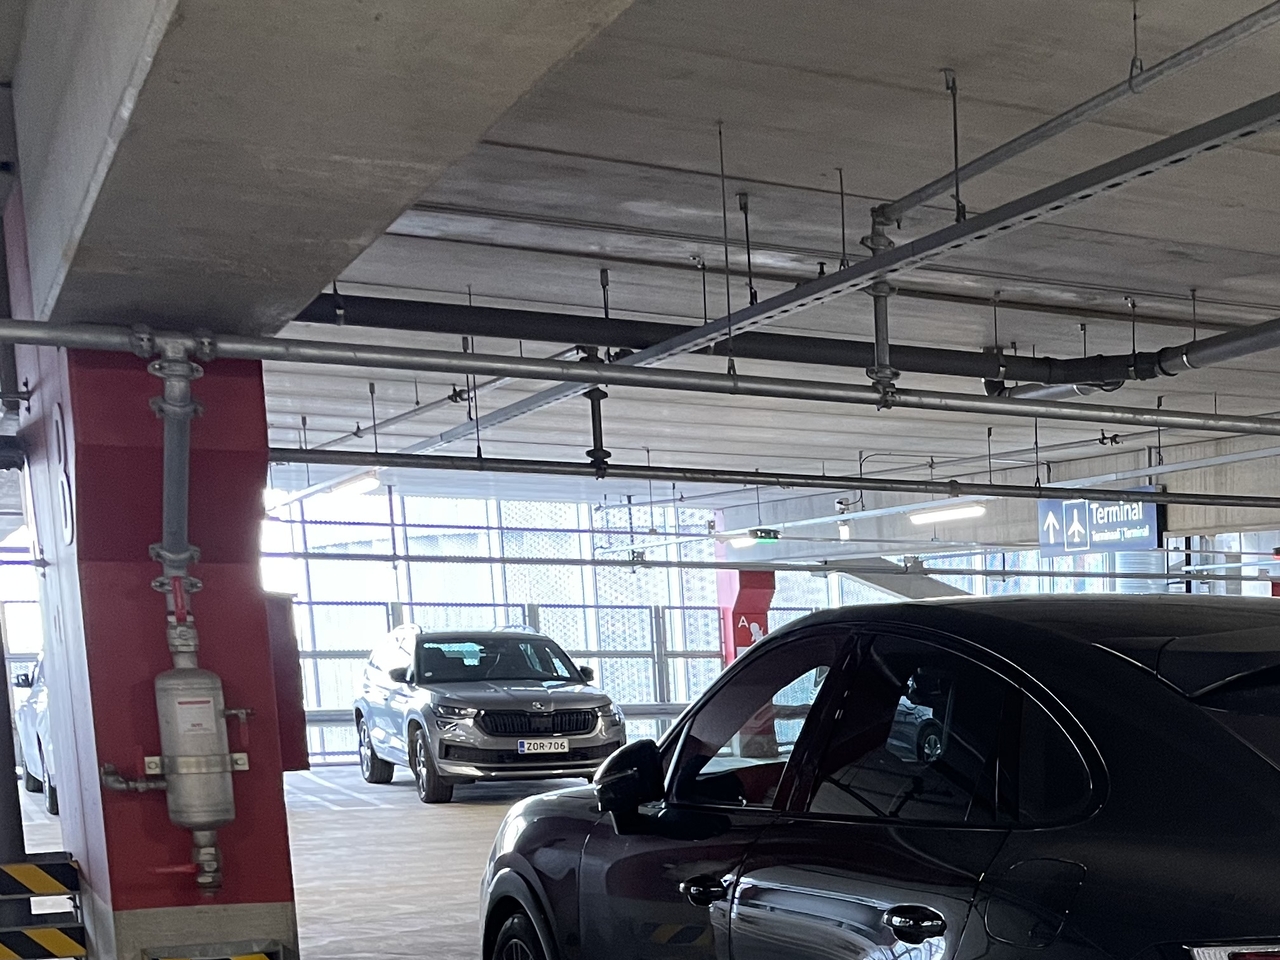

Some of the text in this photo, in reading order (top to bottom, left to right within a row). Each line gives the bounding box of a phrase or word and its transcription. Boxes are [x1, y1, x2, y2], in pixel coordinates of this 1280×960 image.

[1090, 501, 1143, 524] Terminal
[738, 615, 749, 628] A
[526, 741, 566, 752] ZOR-706
